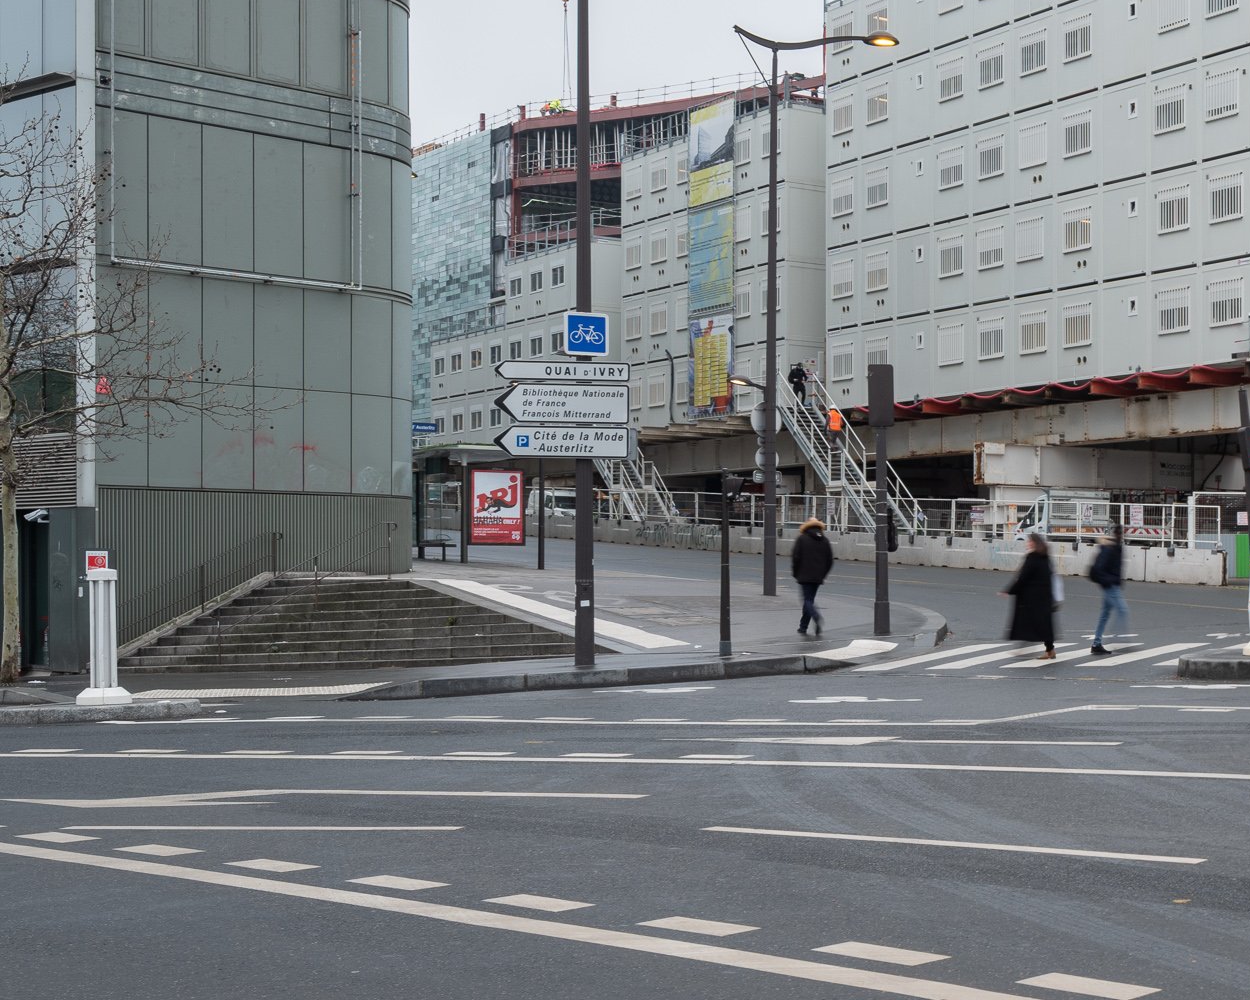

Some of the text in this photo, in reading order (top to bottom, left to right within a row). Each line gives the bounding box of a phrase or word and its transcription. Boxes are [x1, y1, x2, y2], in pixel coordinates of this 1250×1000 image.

[545, 366, 577, 376] QUAI
[522, 388, 624, 399] Bibliothèque Nationale
[522, 399, 566, 407] de France
[521, 410, 611, 419] François Mitterrand
[518, 436, 528, 447] P
[533, 431, 624, 442] Cité de la Mode
